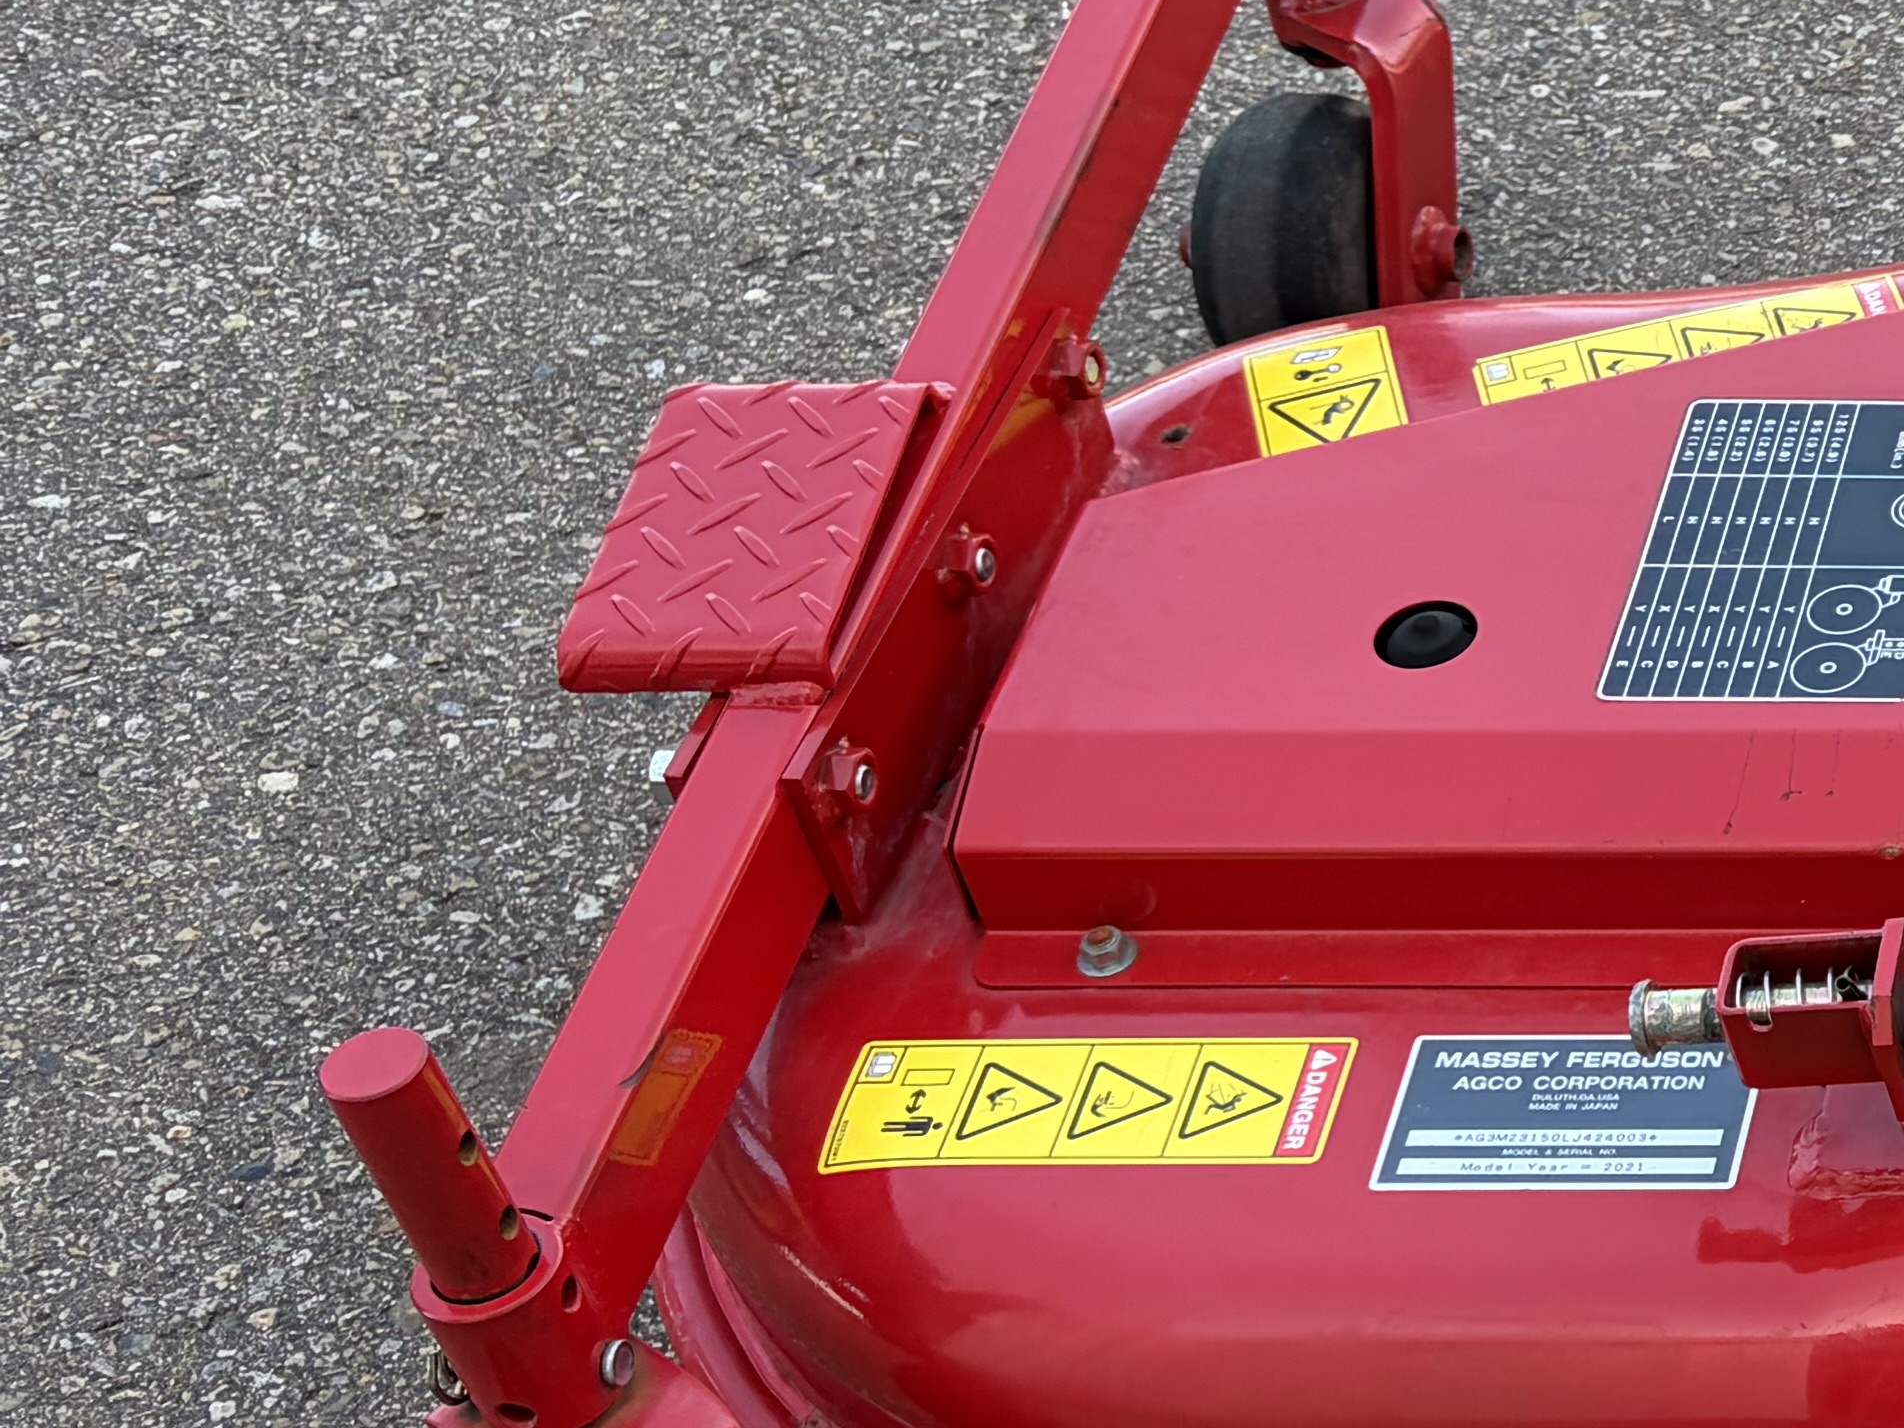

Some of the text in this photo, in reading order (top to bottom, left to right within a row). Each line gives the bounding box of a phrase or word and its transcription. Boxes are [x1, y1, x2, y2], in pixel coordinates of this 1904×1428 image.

[1691, 419, 1706, 432] 35
[1715, 419, 1728, 432] 45
[1762, 419, 1776, 433] 65
[1810, 420, 1824, 433] 95
[1834, 414, 1849, 434] 125
[1682, 436, 1700, 461] (1.4)
[1705, 436, 1724, 461] (1.8)
[1753, 436, 1772, 462] (2.6)
[1801, 437, 1819, 462] (3.7)
[1825, 437, 1844, 463] (4.9)
[1687, 516, 1699, 524] H
[1784, 517, 1796, 525] H
[1808, 517, 1820, 525] H
[1666, 419, 1753, 668] 55 (2.2) H Y D
[1716, 420, 1800, 668] 75 (3.0) H Y C
[1708, 605, 1721, 613] X
[1641, 660, 1654, 668] C
[1767, 661, 1779, 669] A
[1434, 1051, 1724, 1068] MASSEY FERGUSON
[1452, 1076, 1706, 1090] AGCO CORPORATION
[1283, 1072, 1327, 1149] DANGER
[1501, 1148, 1539, 1156] MODEL
[1557, 1148, 1593, 1156] SERIAL
[1460, 1163, 1512, 1172] Model
[1528, 1163, 1569, 1172] Year
[1604, 1162, 1643, 1171] 2021
